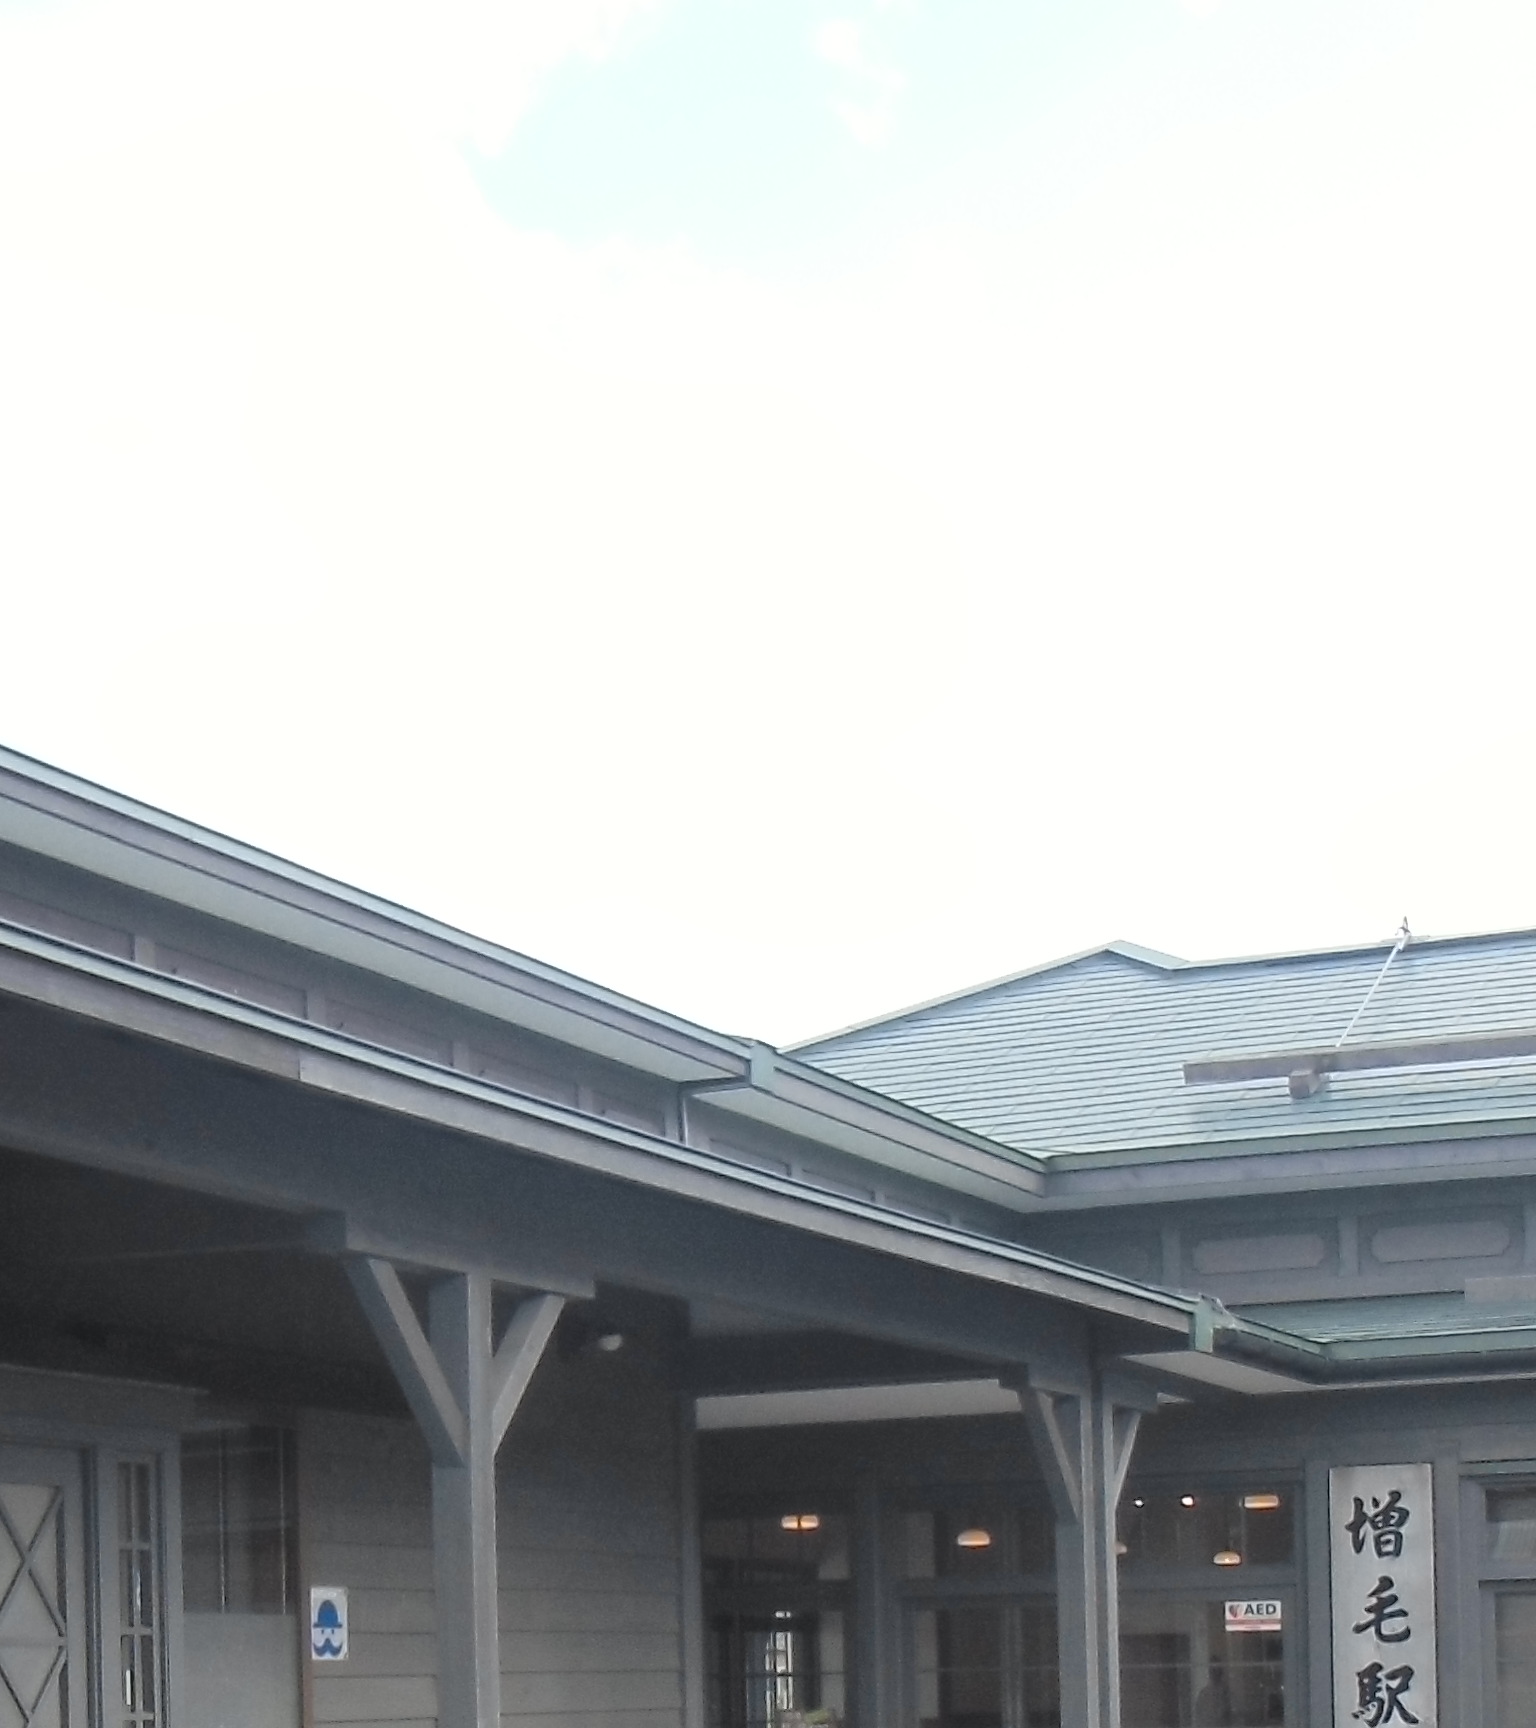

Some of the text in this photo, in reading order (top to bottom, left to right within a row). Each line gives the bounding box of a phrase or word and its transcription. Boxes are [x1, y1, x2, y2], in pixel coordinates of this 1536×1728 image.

[1244, 1603, 1277, 1615] AED
[1344, 1489, 1420, 1728] 増毛駅
